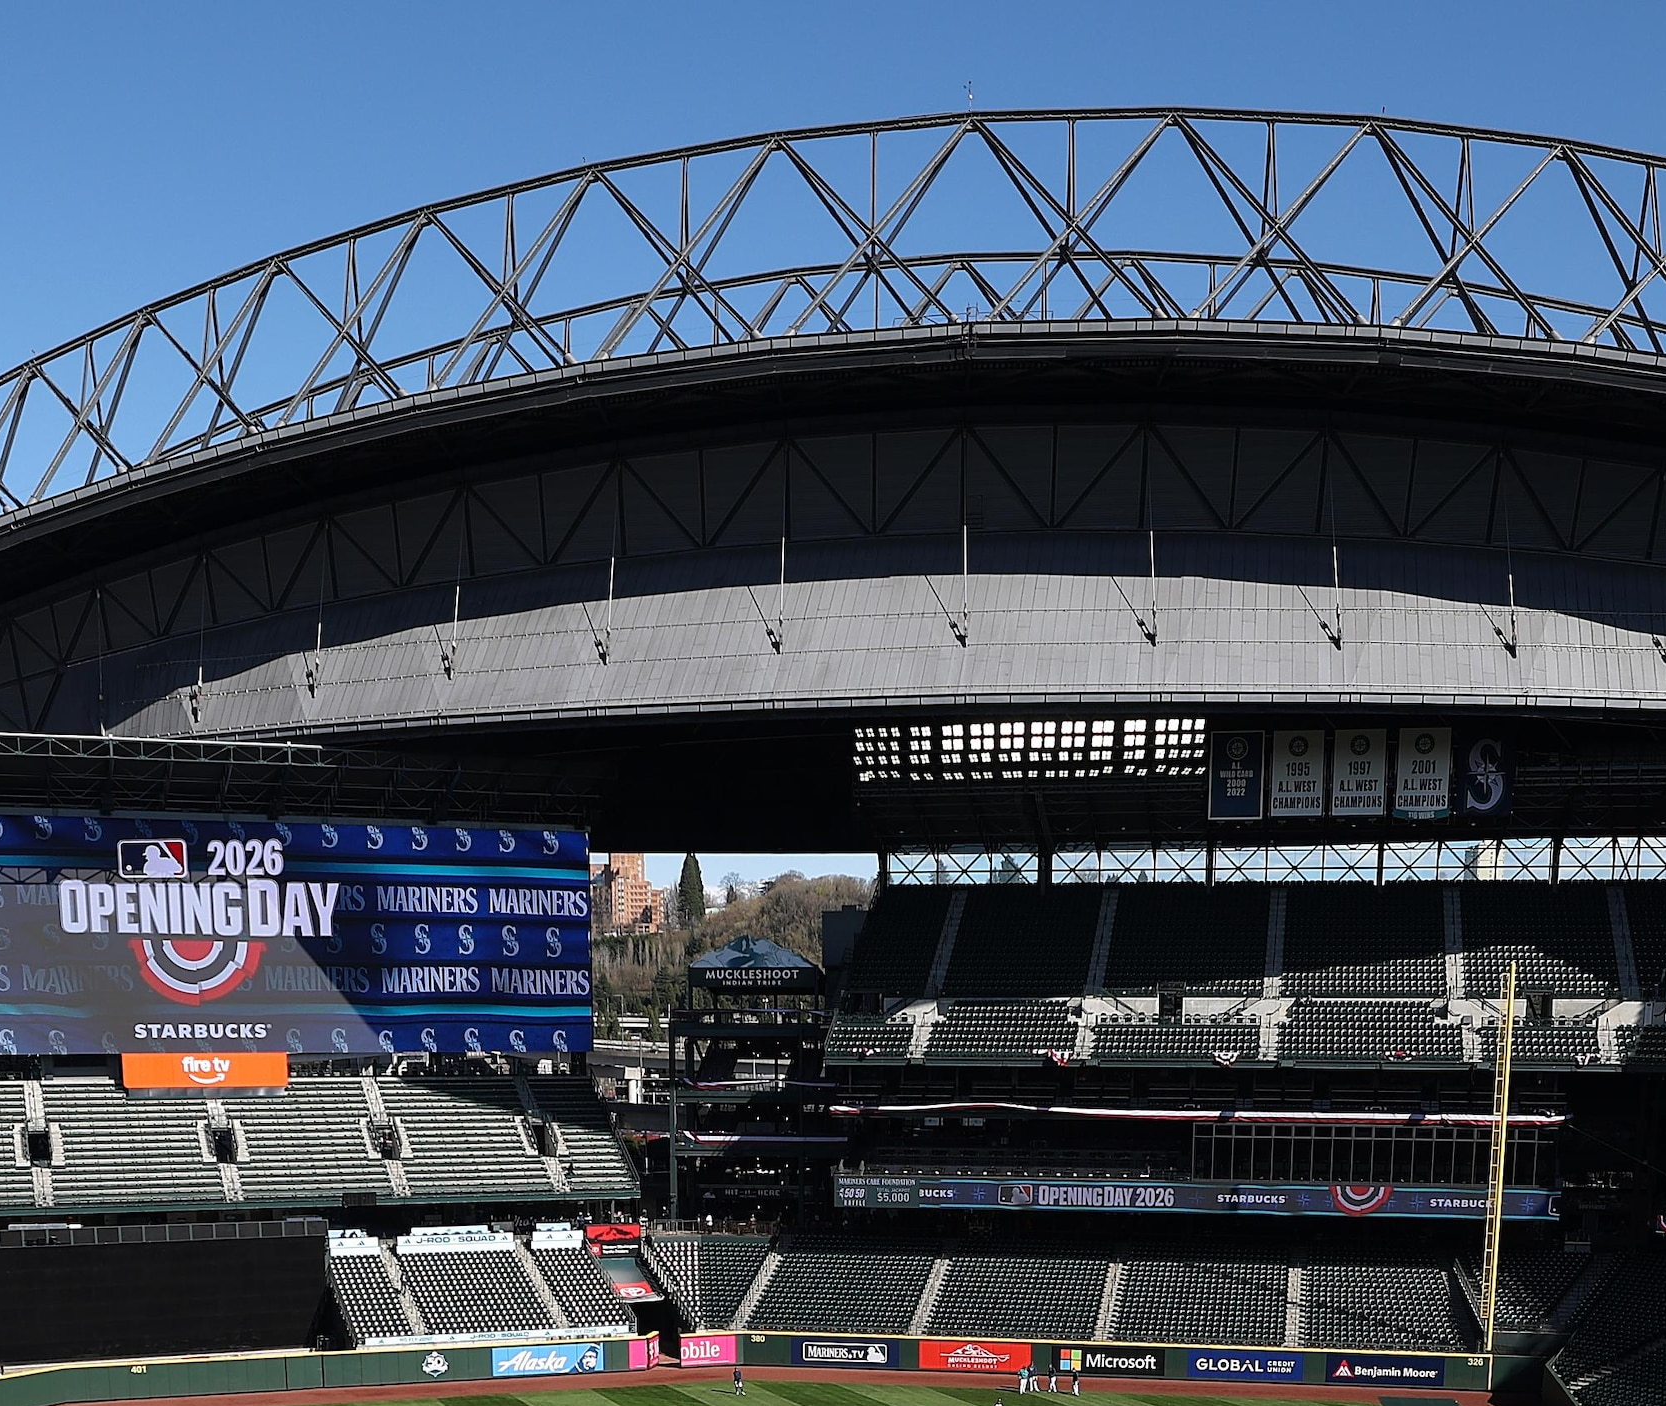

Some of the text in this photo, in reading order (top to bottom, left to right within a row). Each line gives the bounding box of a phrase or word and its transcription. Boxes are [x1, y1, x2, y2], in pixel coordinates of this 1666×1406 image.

[1286, 762, 1310, 776] 1995
[1347, 761, 1372, 775] 1997
[1412, 760, 1437, 774] 2001
[1226, 779, 1247, 788] 2000
[1277, 780, 1317, 793] A.L. WEST
[1339, 779, 1379, 792] A.L. WEST
[1403, 778, 1443, 791] A.L. WEST
[1226, 788, 1246, 797] 2022
[1273, 796, 1321, 809] CHAMPIONS
[1333, 795, 1382, 808] CHAMPIONS
[1397, 794, 1446, 807] CHAMPIONS
[206, 839, 284, 877] 2026
[376, 885, 478, 914] MARINERS
[488, 887, 589, 917] MARINERS
[58, 879, 244, 936] OPENING
[247, 878, 340, 938] DAY
[264, 965, 590, 996] MARINERS MARINERS MARINERS
[705, 968, 800, 980] MUCKLESHOOT
[134, 1023, 268, 1040] STARBUCKS
[181, 1057, 231, 1073] fire tv
[877, 1192, 910, 1203] $5,000
[1038, 1186, 1174, 1207] OPENING DAY 2026
[1217, 1194, 1286, 1204] STARBUCKS
[1430, 1198, 1495, 1208] STARBUCK
[416, 1233, 496, 1245] J-ROD SQUAD
[750, 1335, 765, 1343] 380
[681, 1341, 720, 1358] obile
[427, 1357, 445, 1368] 50
[497, 1350, 568, 1373] Alaska
[1085, 1353, 1156, 1370] Microsoft
[1196, 1357, 1264, 1373] GLOBAL
[1467, 1357, 1484, 1366] 326
[130, 1366, 147, 1374] 401
[1354, 1366, 1438, 1380] Benjamin Moore
